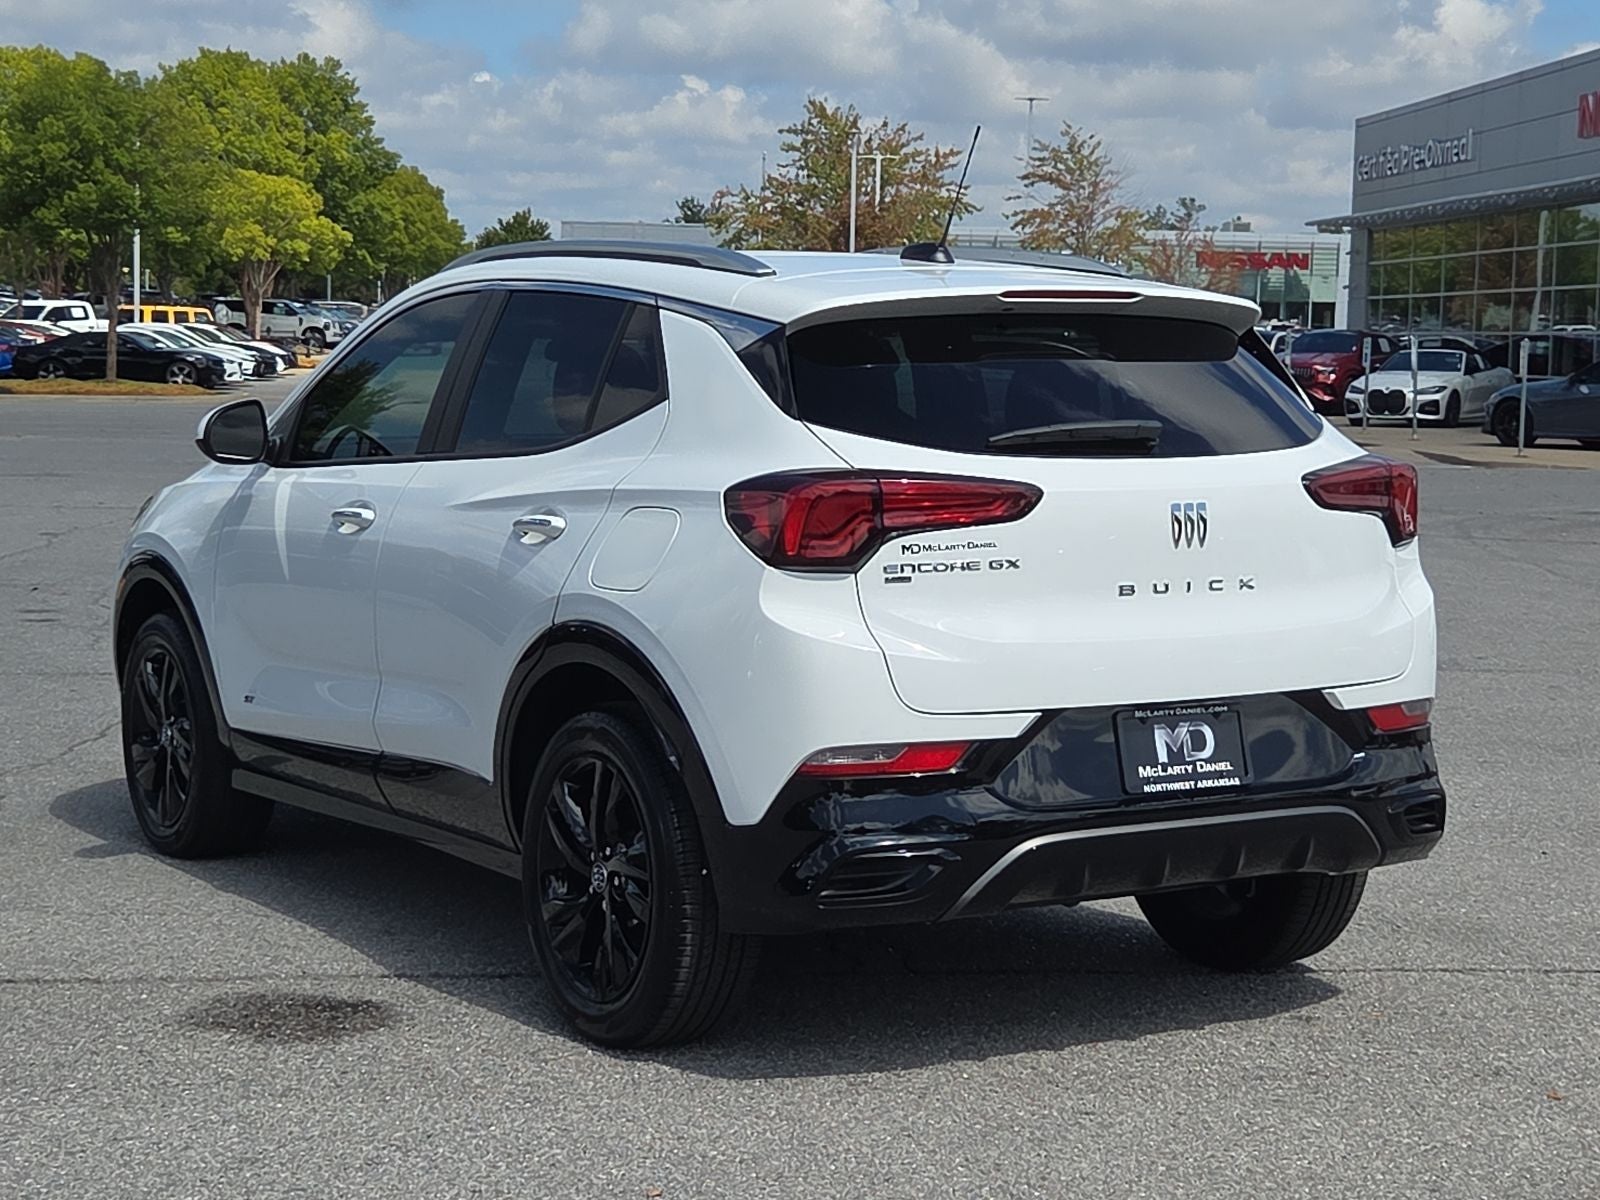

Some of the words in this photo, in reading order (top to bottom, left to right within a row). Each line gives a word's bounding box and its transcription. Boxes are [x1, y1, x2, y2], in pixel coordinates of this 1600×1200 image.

[883, 561, 981, 575] ENCORE
[988, 559, 1020, 571] GX
[1118, 578, 1256, 597] BUICK
[1196, 761, 1235, 773] DANIEL
[1143, 779, 1195, 793] NORTHWEST
[1196, 777, 1241, 789] ARKANSAS
